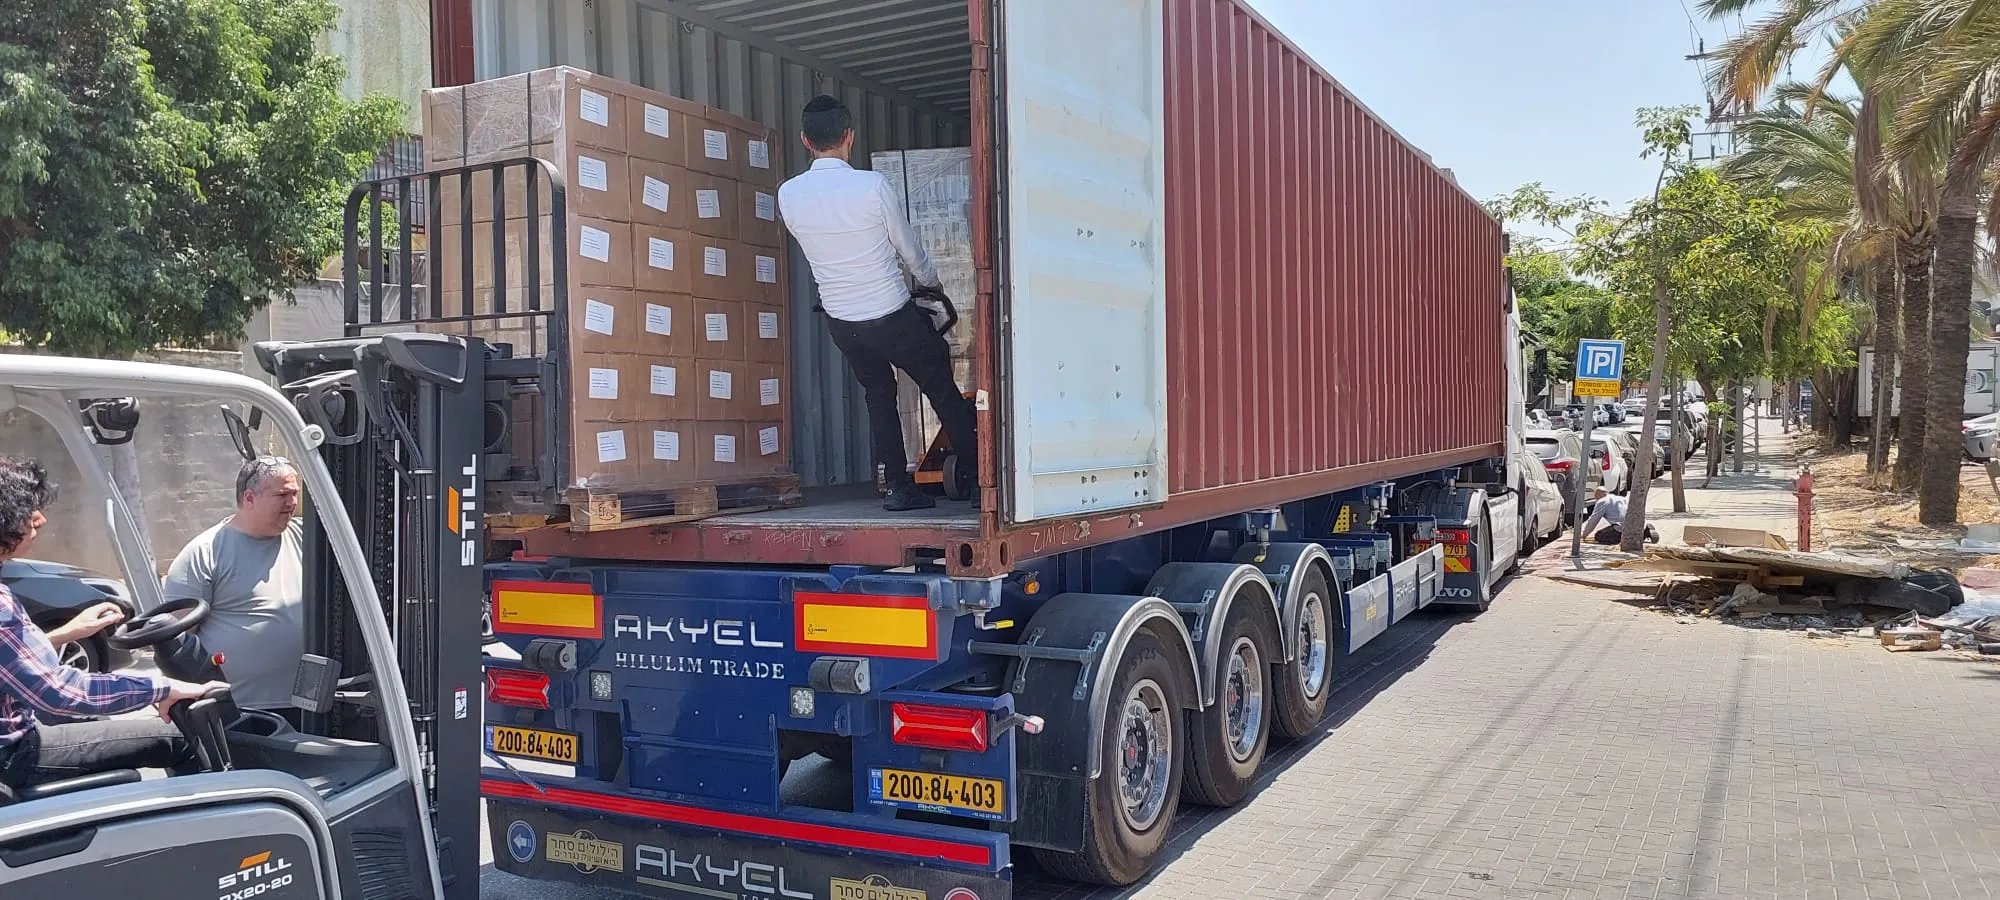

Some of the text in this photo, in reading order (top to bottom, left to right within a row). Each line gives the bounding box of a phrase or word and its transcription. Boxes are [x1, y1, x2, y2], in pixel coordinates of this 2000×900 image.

[461, 453, 477, 566] STILL
[614, 614, 784, 648] AKYEL
[615, 652, 785, 680] HILULIM TRADE
[550, 838, 618, 858] הילולים סחר
[218, 857, 292, 889] STILL
[635, 844, 814, 900] AKYEL
[835, 884, 864, 899] סחר
